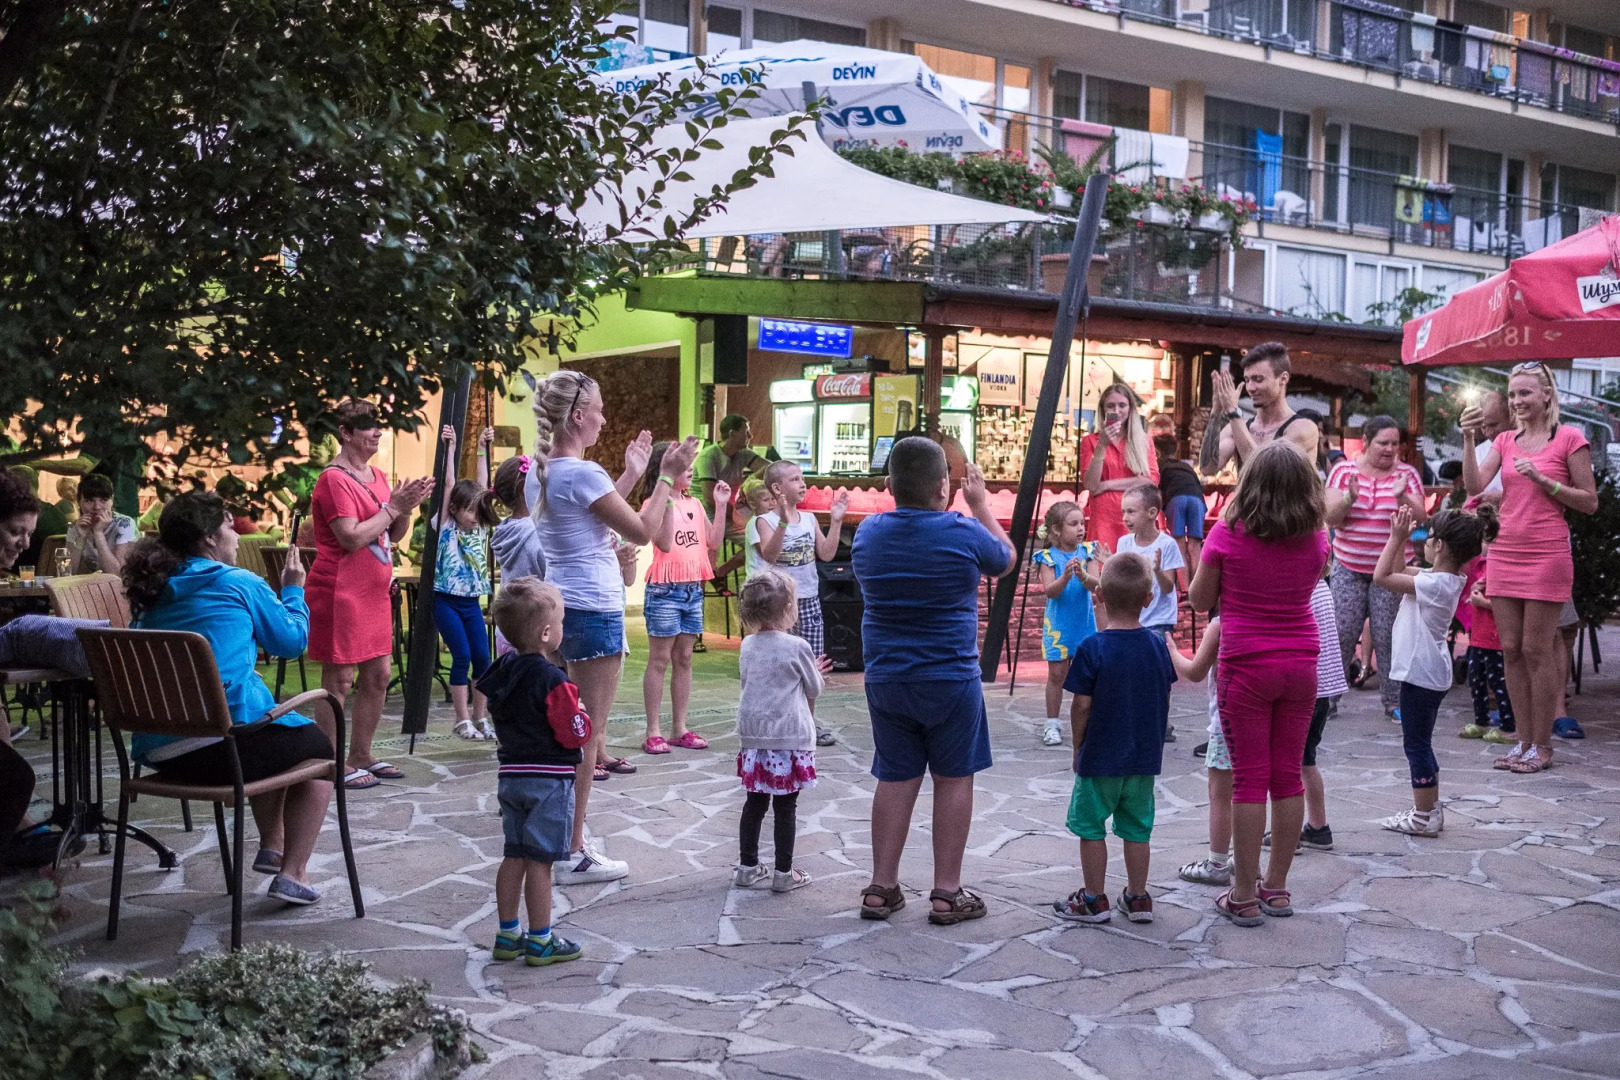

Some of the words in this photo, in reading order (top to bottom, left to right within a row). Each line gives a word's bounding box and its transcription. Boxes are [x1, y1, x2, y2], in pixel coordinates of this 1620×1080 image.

[721, 72, 762, 85] DEVN
[833, 66, 876, 80] DEVIN
[980, 373, 1016, 385] FINLANDIA
